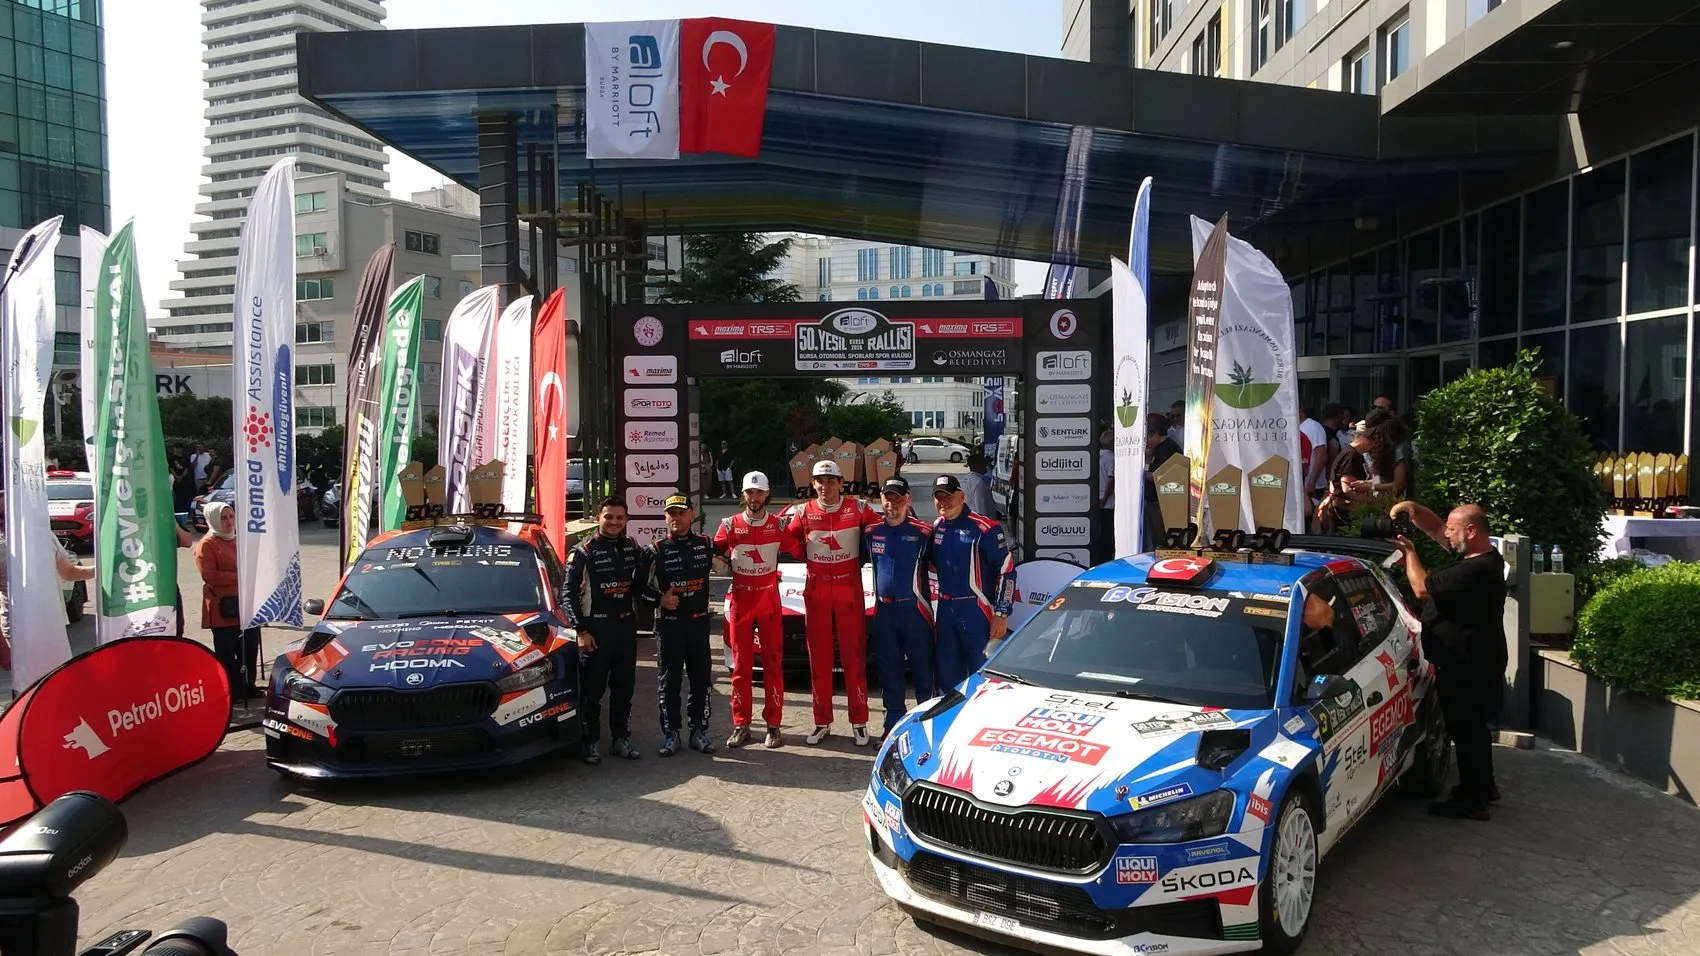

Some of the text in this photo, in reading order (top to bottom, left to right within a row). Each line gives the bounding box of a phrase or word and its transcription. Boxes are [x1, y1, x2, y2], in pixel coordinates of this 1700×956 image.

[611, 47, 620, 127] BY MARRIOTT
[628, 35, 663, 138] aloft
[839, 315, 869, 327] aloft
[973, 323, 998, 332] TRS
[750, 325, 775, 334] TRS
[247, 296, 263, 401] Assistance
[720, 348, 763, 363] aloft
[799, 352, 818, 360] BURSA
[847, 352, 875, 360] SPORLARI
[875, 352, 890, 360] SPOR
[1042, 353, 1089, 369] aloft
[646, 366, 673, 375] maxima
[634, 460, 670, 476] Salados
[1041, 458, 1083, 469] bidijital
[246, 459, 267, 534] Remed
[1041, 525, 1086, 537] digiwuu
[1211, 529, 1246, 552] 50
[385, 544, 512, 561] NOTHING
[813, 552, 851, 562] Petrol Ofisi
[361, 563, 373, 574] 2
[737, 566, 772, 575] Petrol Ofisi
[1048, 597, 1066, 611] 3
[361, 638, 484, 652] EVOFONE
[371, 647, 472, 660] RACING
[107, 679, 205, 738] Petrol Ofisi
[518, 703, 572, 728] EVOFONE
[1029, 707, 1106, 726] LIQUI
[1319, 712, 1329, 734] 3
[1372, 690, 1409, 744] EGEMOT
[268, 719, 314, 741] EVOFONE
[1018, 717, 1094, 736] MOLY
[979, 729, 1101, 758] EGEMOT
[1148, 786, 1184, 802] MICHELIN
[1250, 797, 1269, 816] ibis
[1190, 846, 1226, 857] RAVENOL
[1117, 857, 1156, 871] LIQUI
[1117, 870, 1157, 883] MOLY
[1162, 866, 1255, 893] ŠKODA
